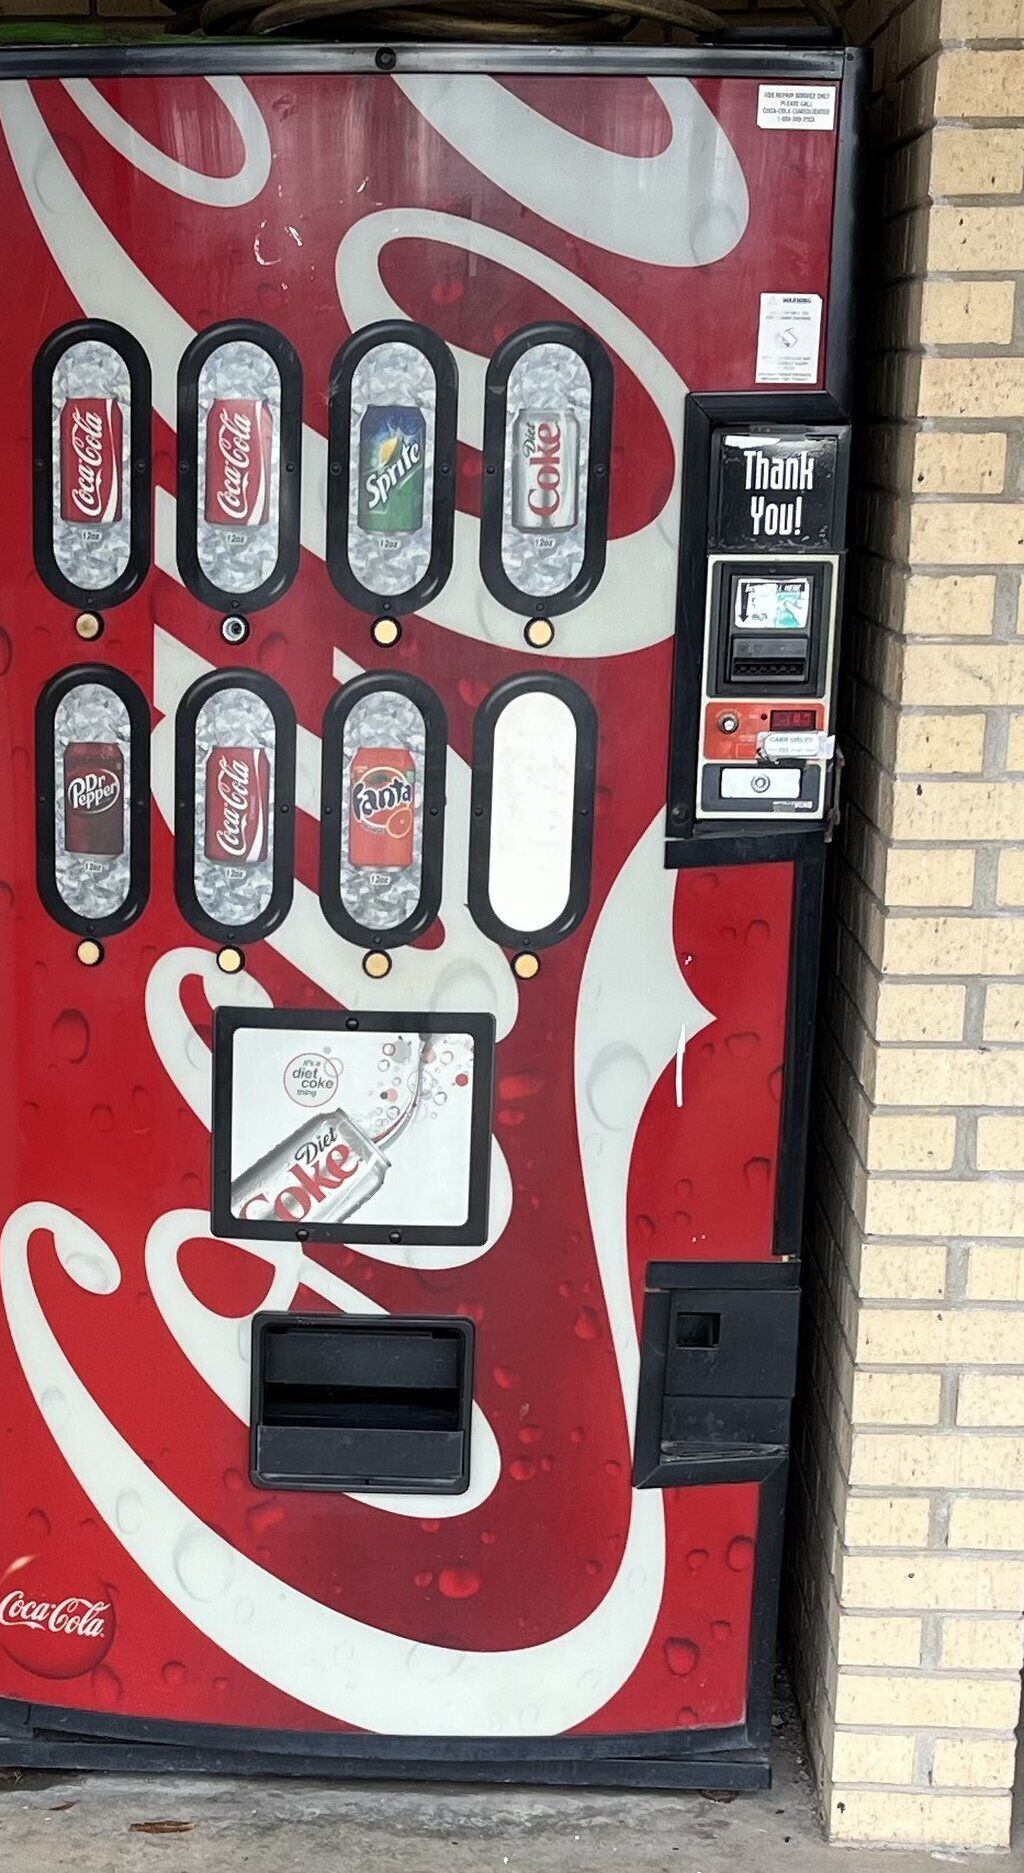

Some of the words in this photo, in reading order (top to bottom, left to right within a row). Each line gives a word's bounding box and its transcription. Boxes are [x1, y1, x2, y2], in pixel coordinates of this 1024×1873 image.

[523, 421, 536, 458] Diet
[365, 440, 421, 509] Sprite
[527, 421, 562, 518] Coke
[743, 450, 815, 490] Thank
[750, 496, 803, 536] You!
[68, 777, 119, 810] Pepper
[85, 773, 106, 792] Dr
[352, 777, 413, 820] Fanta
[292, 1067, 318, 1079] diet
[301, 1077, 334, 1089] coke
[296, 1089, 317, 1098] thing
[294, 1126, 337, 1165] Diet
